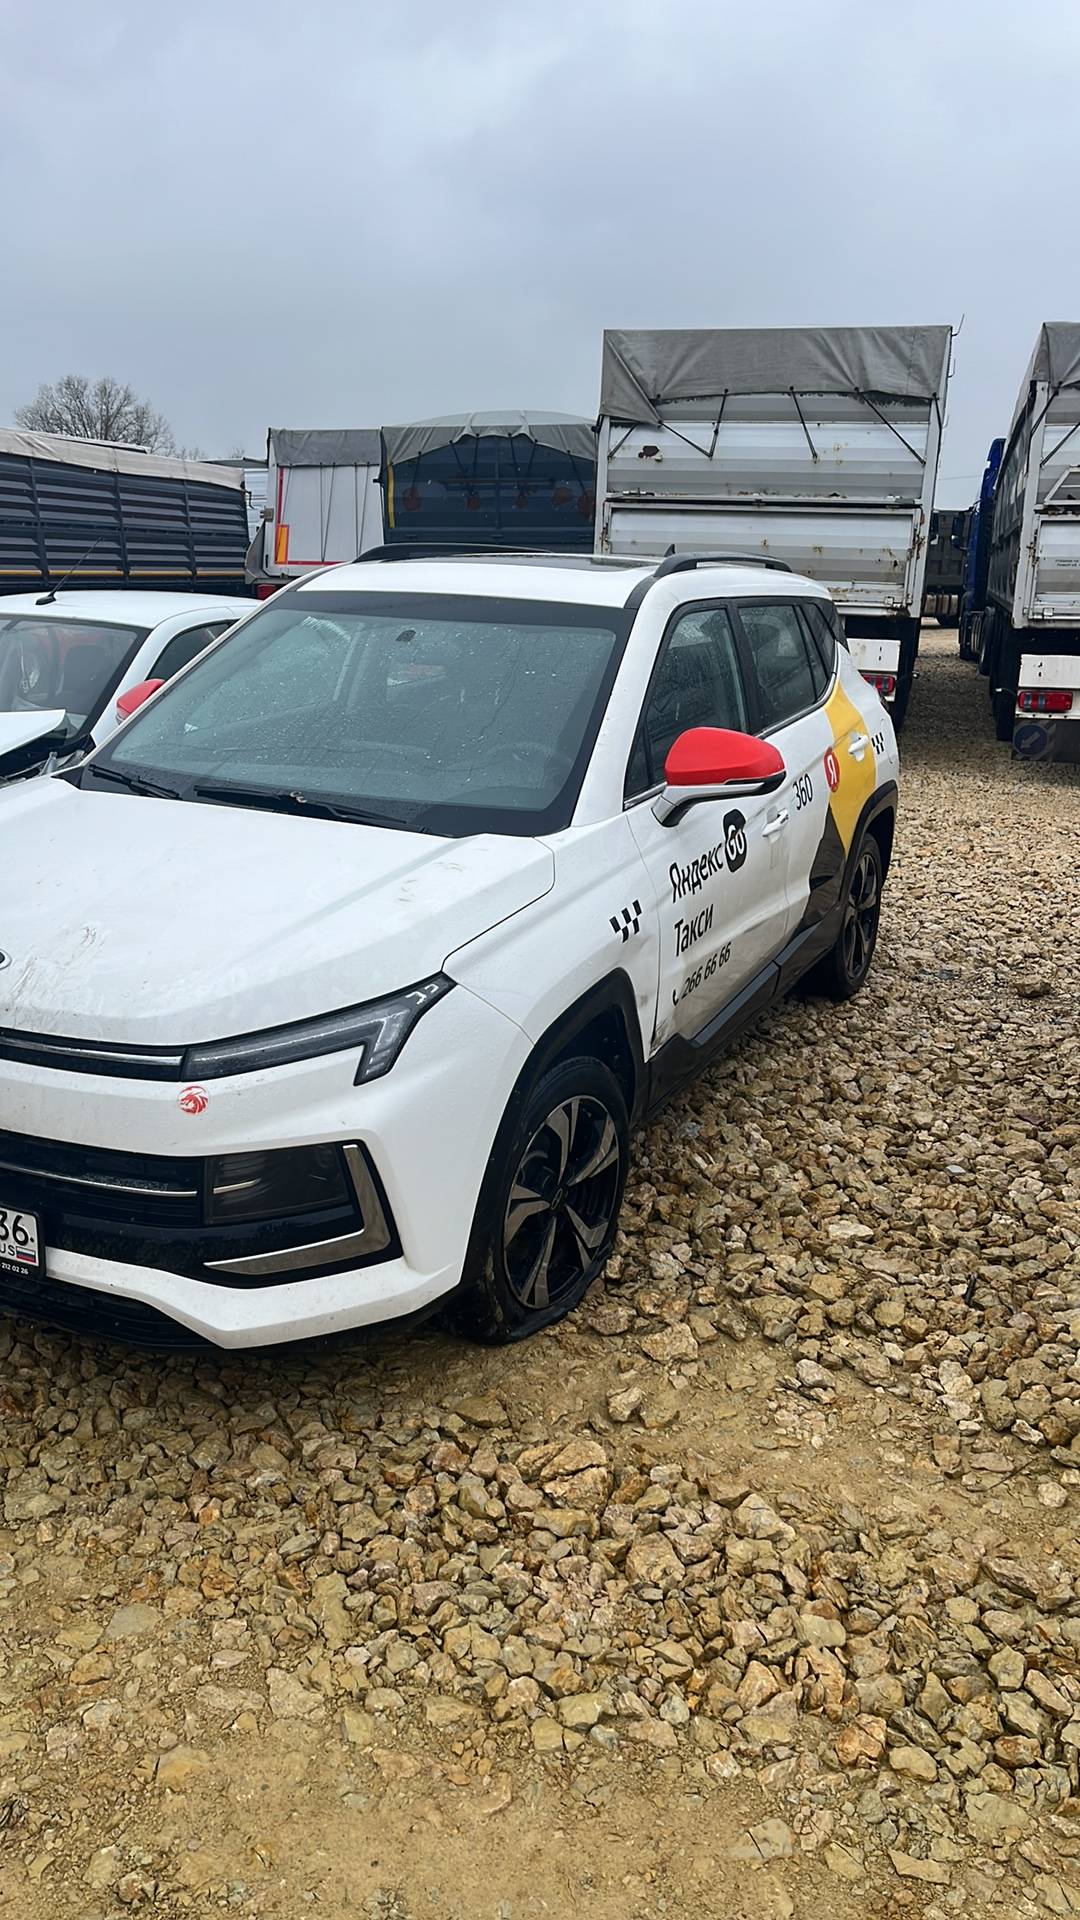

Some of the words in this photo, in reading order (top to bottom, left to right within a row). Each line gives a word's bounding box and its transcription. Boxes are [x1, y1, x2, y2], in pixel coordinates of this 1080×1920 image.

[792, 773, 813, 811] 360
[826, 753, 838, 786] Я
[669, 842, 724, 904] Яндекс
[674, 903, 714, 958] Такси
[681, 965, 704, 1000] 266
[703, 953, 718, 981] 66
[718, 941, 732, 968] 66
